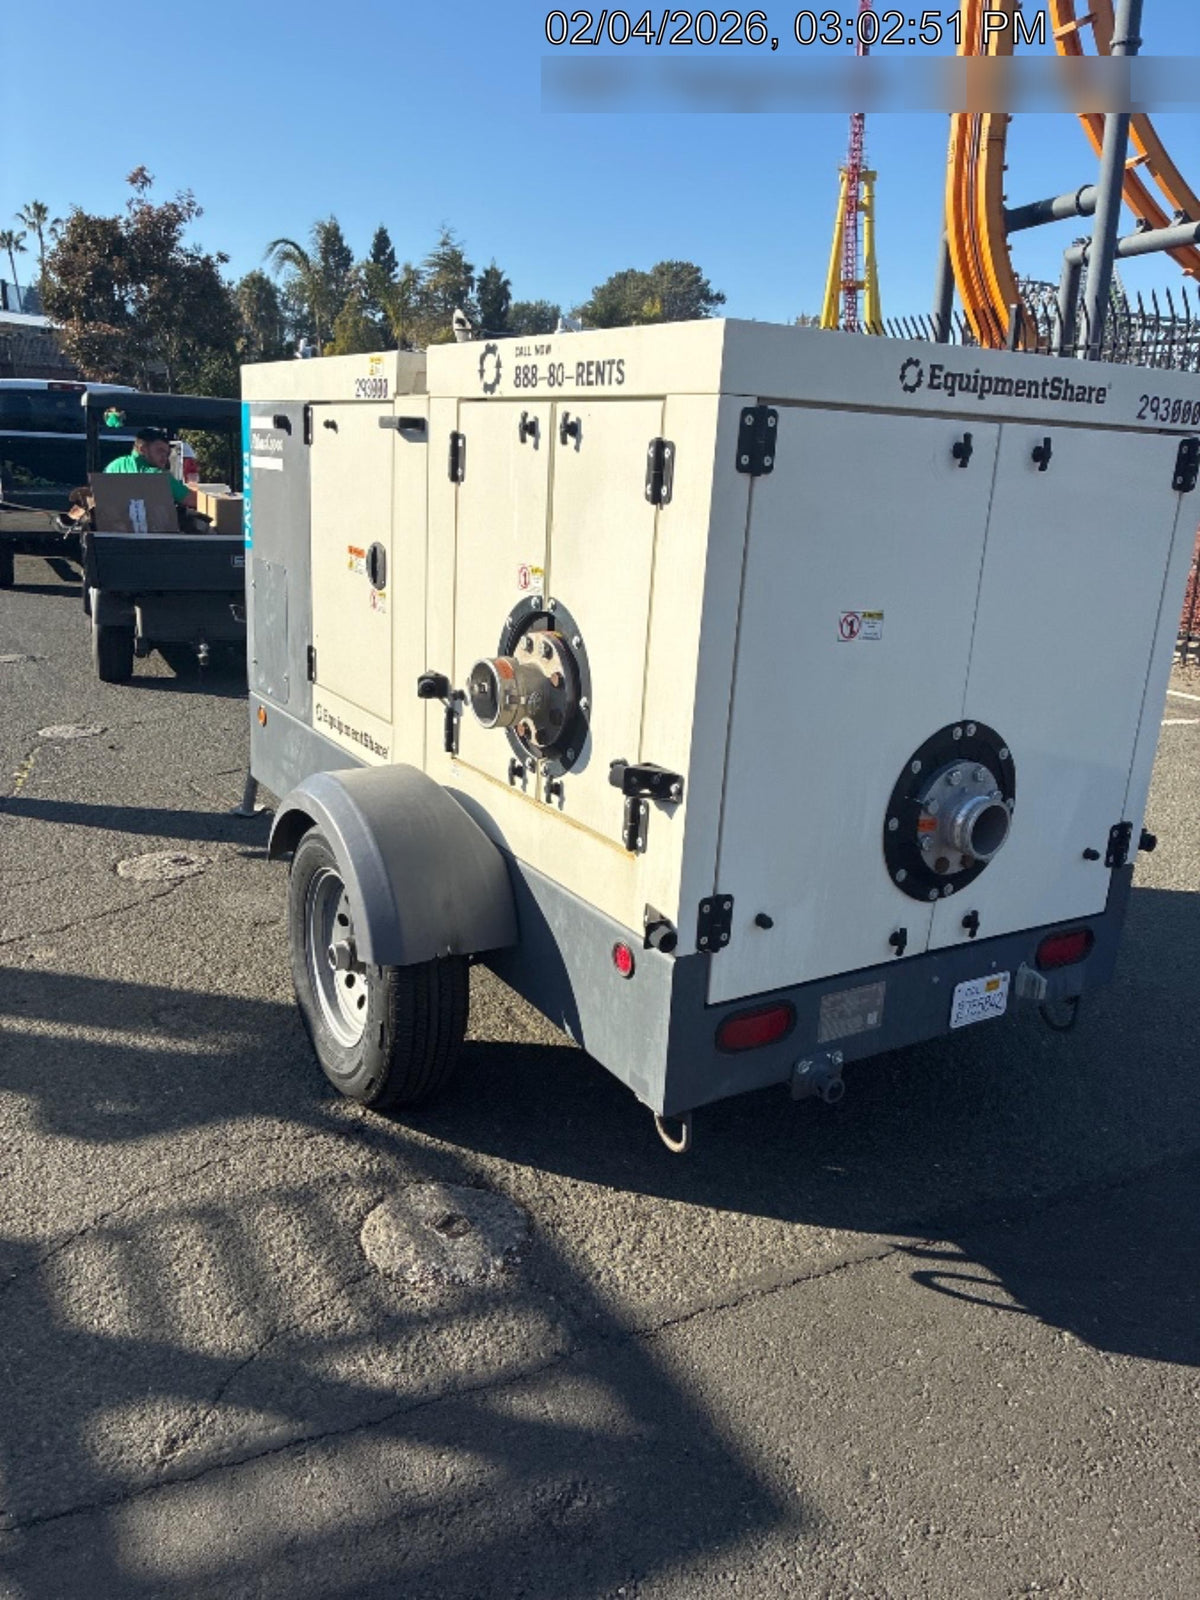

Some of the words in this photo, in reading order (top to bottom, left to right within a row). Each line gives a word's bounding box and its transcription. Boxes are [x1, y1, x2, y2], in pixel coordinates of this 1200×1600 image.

[355, 377, 388, 399] 293000
[513, 358, 626, 389] 888-80-RENTS
[927, 363, 1108, 405] EquipmentShare
[1136, 393, 1200, 426] 293000
[322, 707, 389, 760] EquipmentShare
